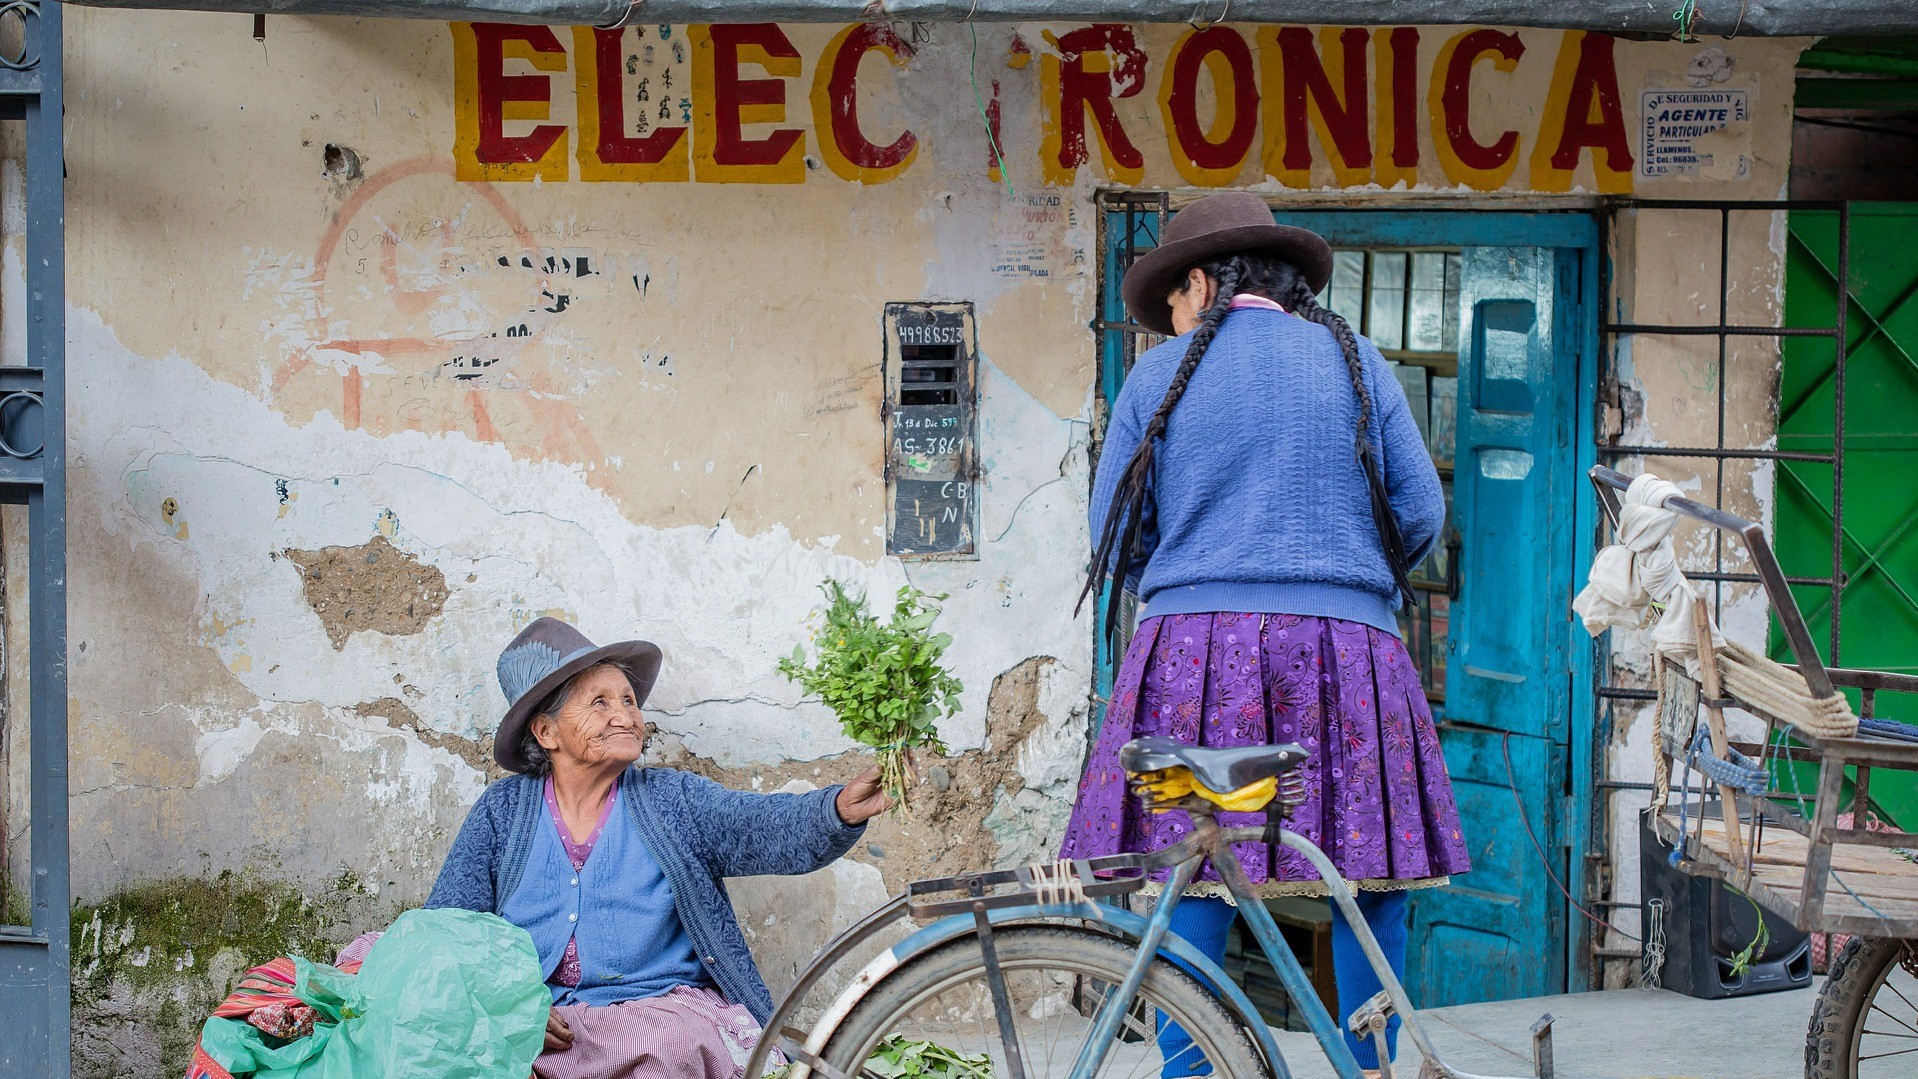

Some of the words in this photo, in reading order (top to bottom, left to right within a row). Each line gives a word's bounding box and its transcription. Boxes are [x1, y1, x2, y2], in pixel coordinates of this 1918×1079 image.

[1649, 95, 1664, 110] DE
[1666, 94, 1724, 103] SEGURIDAD
[1725, 94, 1732, 103] Y
[451, 22, 1635, 194] ELECRONICA
[1659, 109, 1728, 121] AGENTE
[1647, 116, 1655, 173] SERVICIO
[899, 326, 964, 343] 49988523
[942, 506, 958, 523] N
